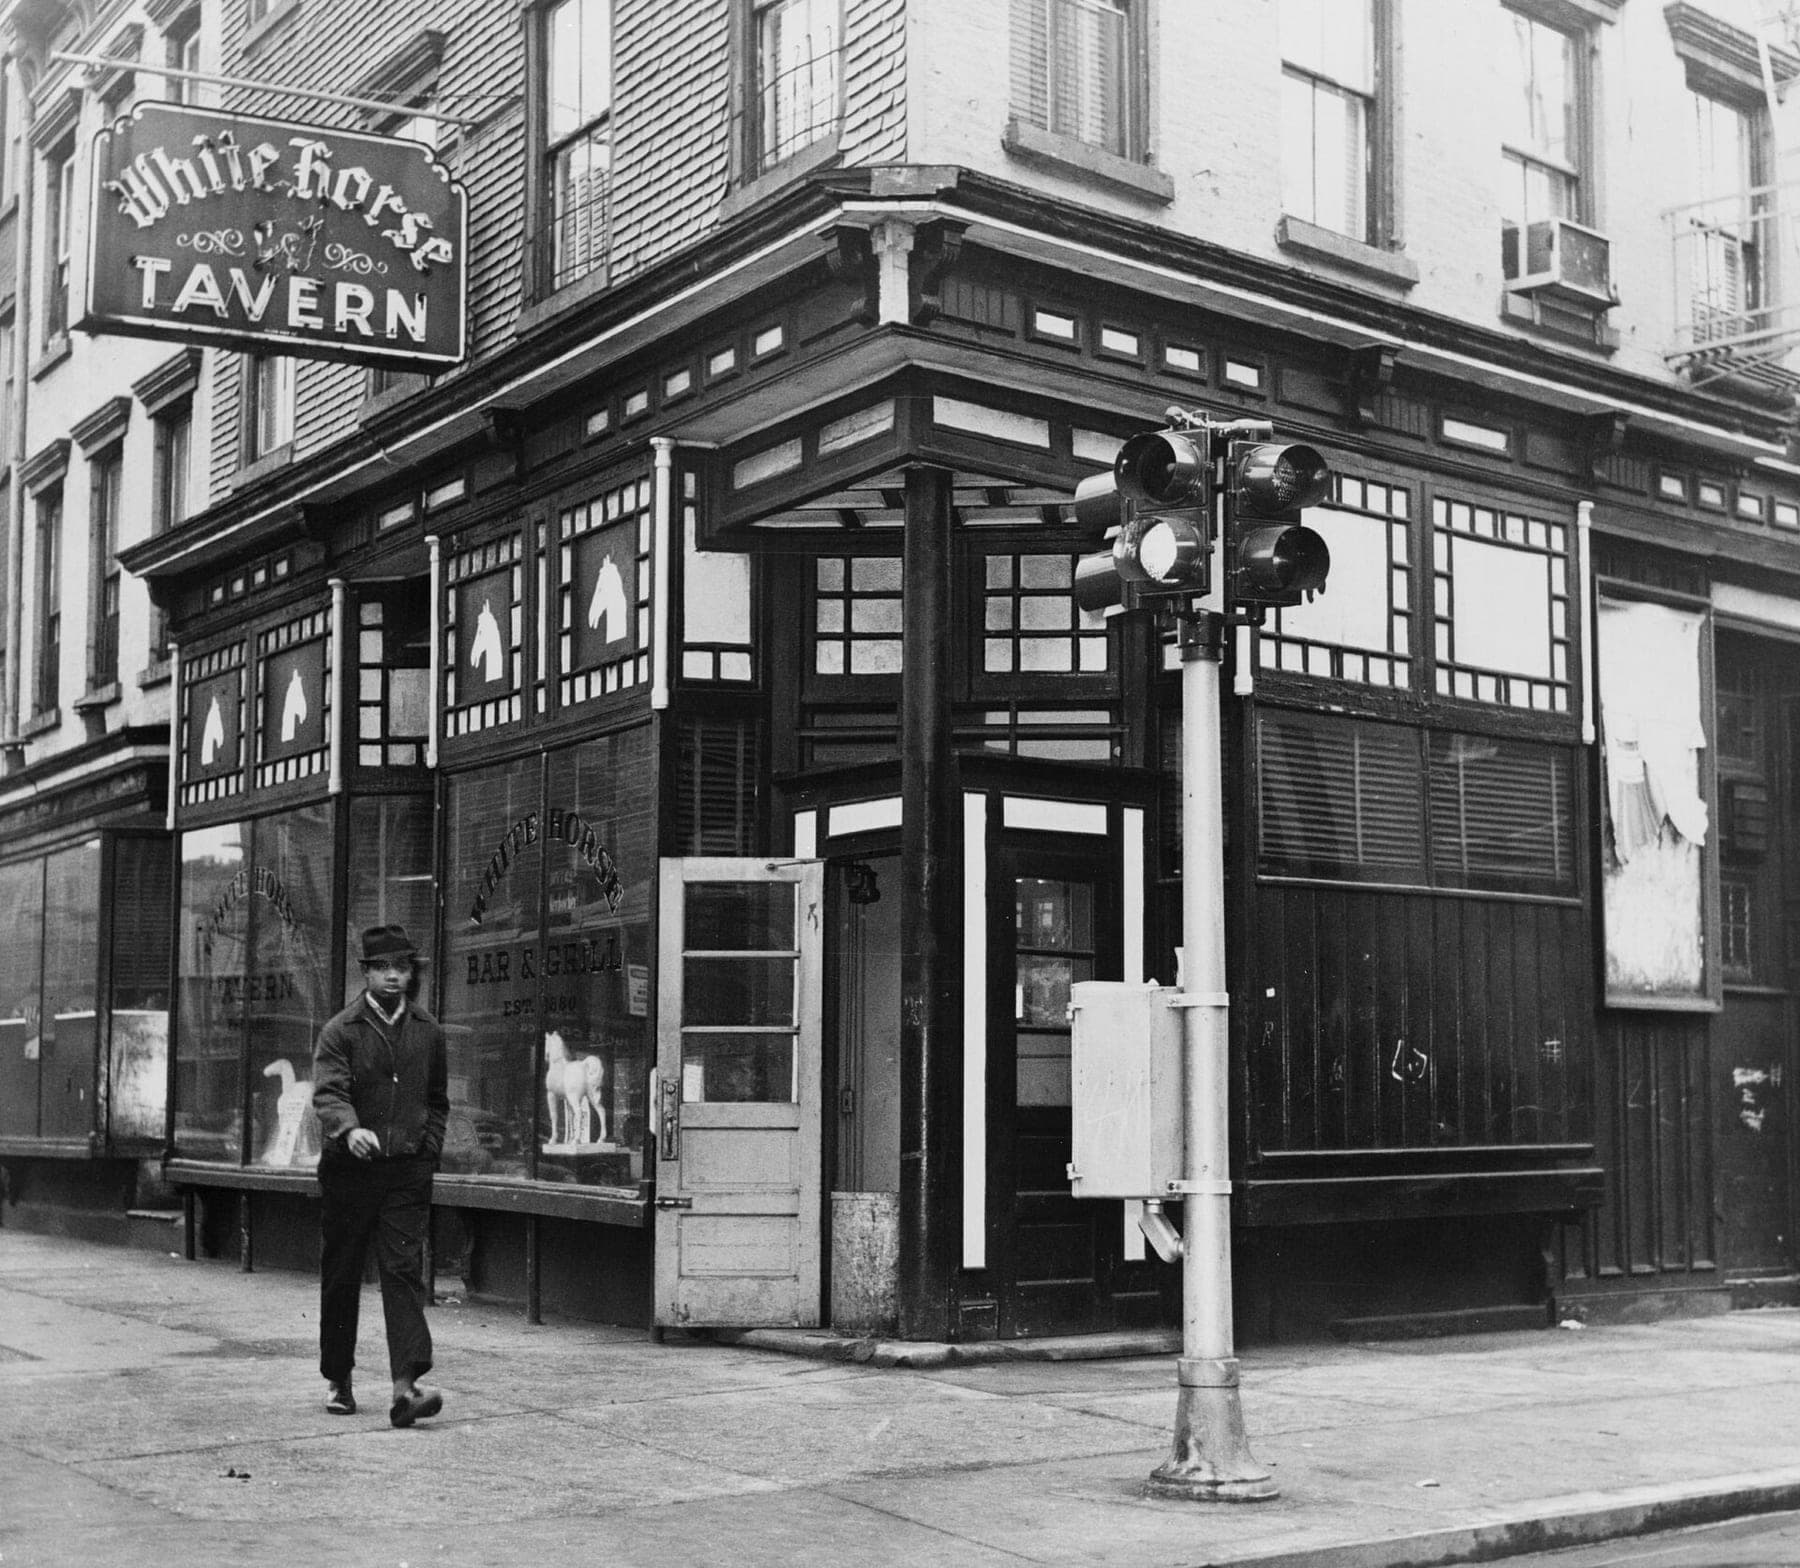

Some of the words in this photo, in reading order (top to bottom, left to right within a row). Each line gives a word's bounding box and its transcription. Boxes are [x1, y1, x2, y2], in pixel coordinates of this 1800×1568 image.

[103, 130, 281, 229] White
[134, 254, 428, 343] TAVERN
[470, 811, 538, 925] WHITE
[549, 808, 624, 916] HORSE
[466, 950, 511, 985] BAR
[521, 948, 536, 980] &
[547, 938, 624, 977] GRILL
[503, 998, 535, 1017] EST.
